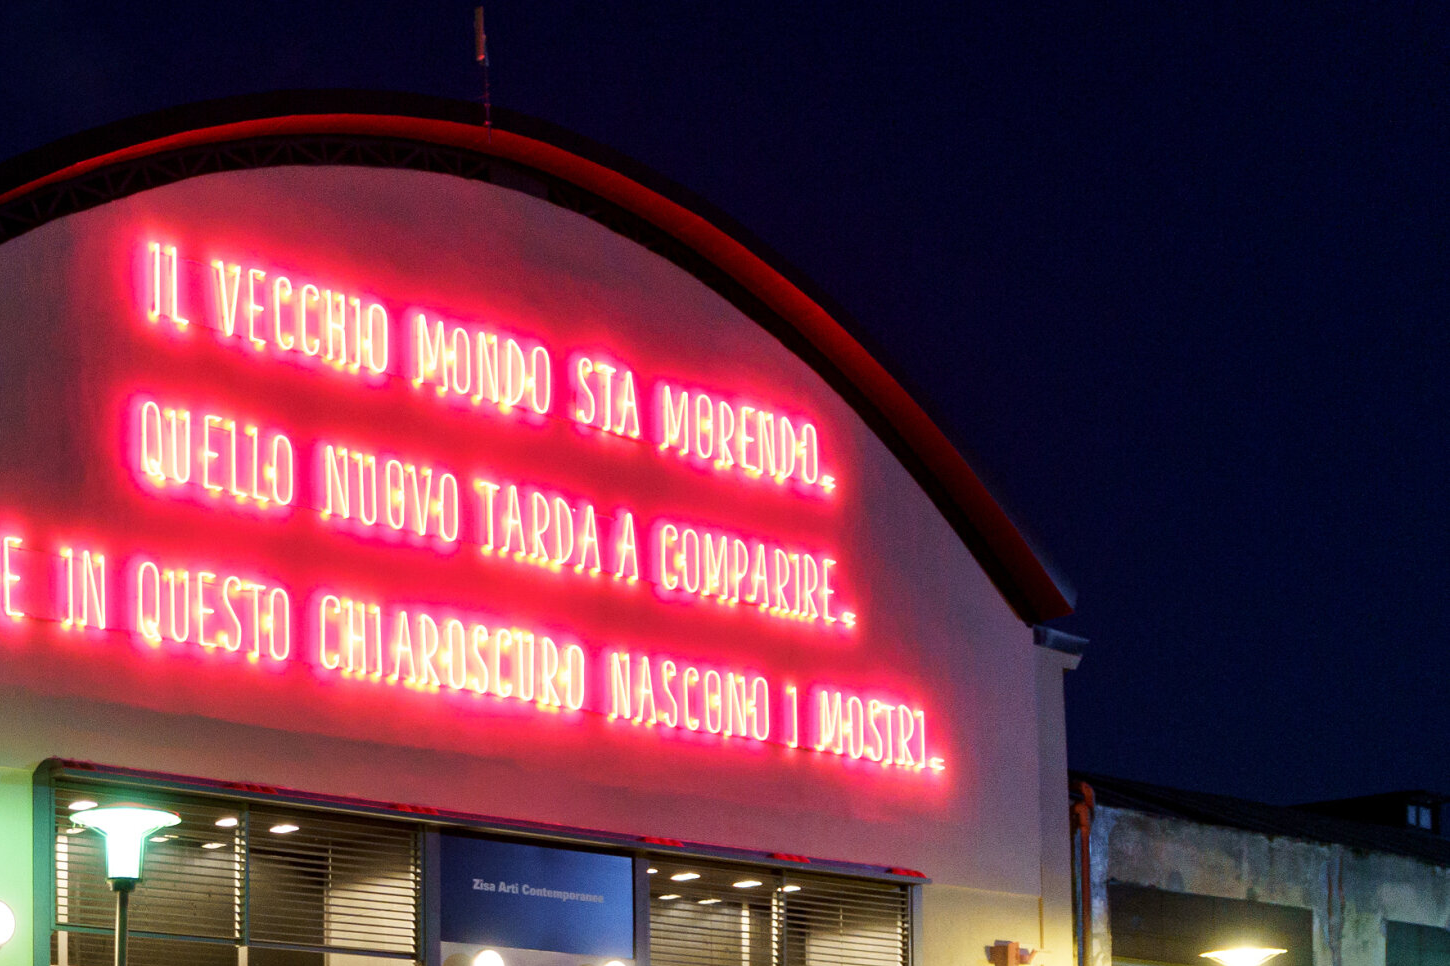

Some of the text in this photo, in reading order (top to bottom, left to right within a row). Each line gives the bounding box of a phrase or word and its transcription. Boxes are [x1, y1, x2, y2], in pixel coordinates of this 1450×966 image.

[148, 242, 836, 491] IL VECCHIO MONDO STA MORENDO.
[141, 401, 856, 628] QUELLO NUOVO TARDA A COMPARIRE.
[2, 536, 25, 621] E
[60, 547, 106, 631] IN
[137, 561, 291, 662] QUESTO
[319, 595, 586, 711] CHIAROSCURO
[608, 651, 771, 741] NASCONO
[814, 690, 946, 771] MOSTRI.
[472, 879, 605, 903] Zisa Arti Contemporanee
